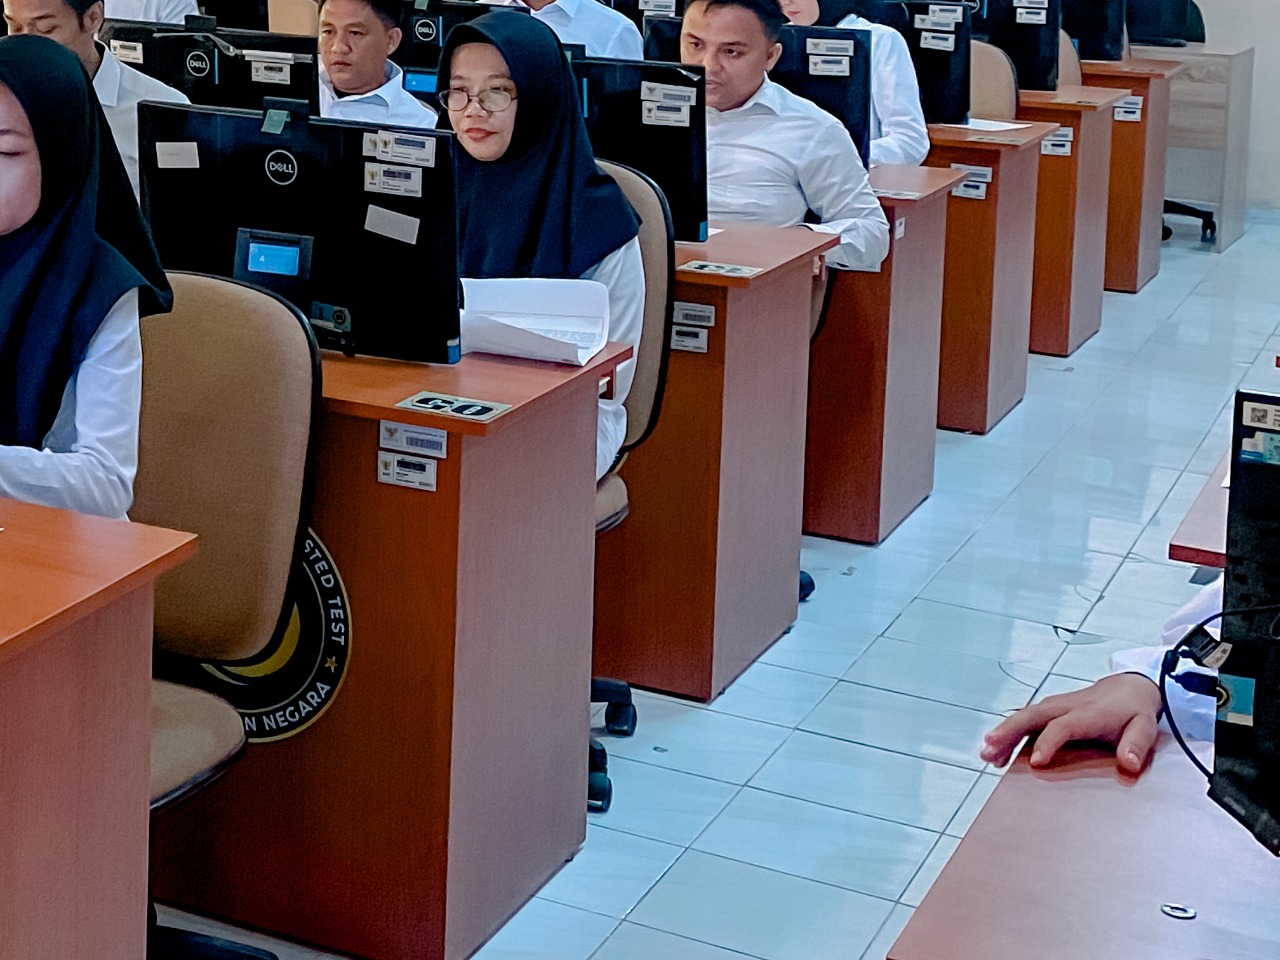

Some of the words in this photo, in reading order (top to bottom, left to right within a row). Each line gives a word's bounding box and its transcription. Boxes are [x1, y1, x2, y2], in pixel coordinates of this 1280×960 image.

[190, 59, 207, 68] DELL
[270, 162, 294, 173] DELL
[305, 539, 335, 588] STED
[328, 596, 345, 646] TEST
[263, 681, 331, 731] NEGARA
